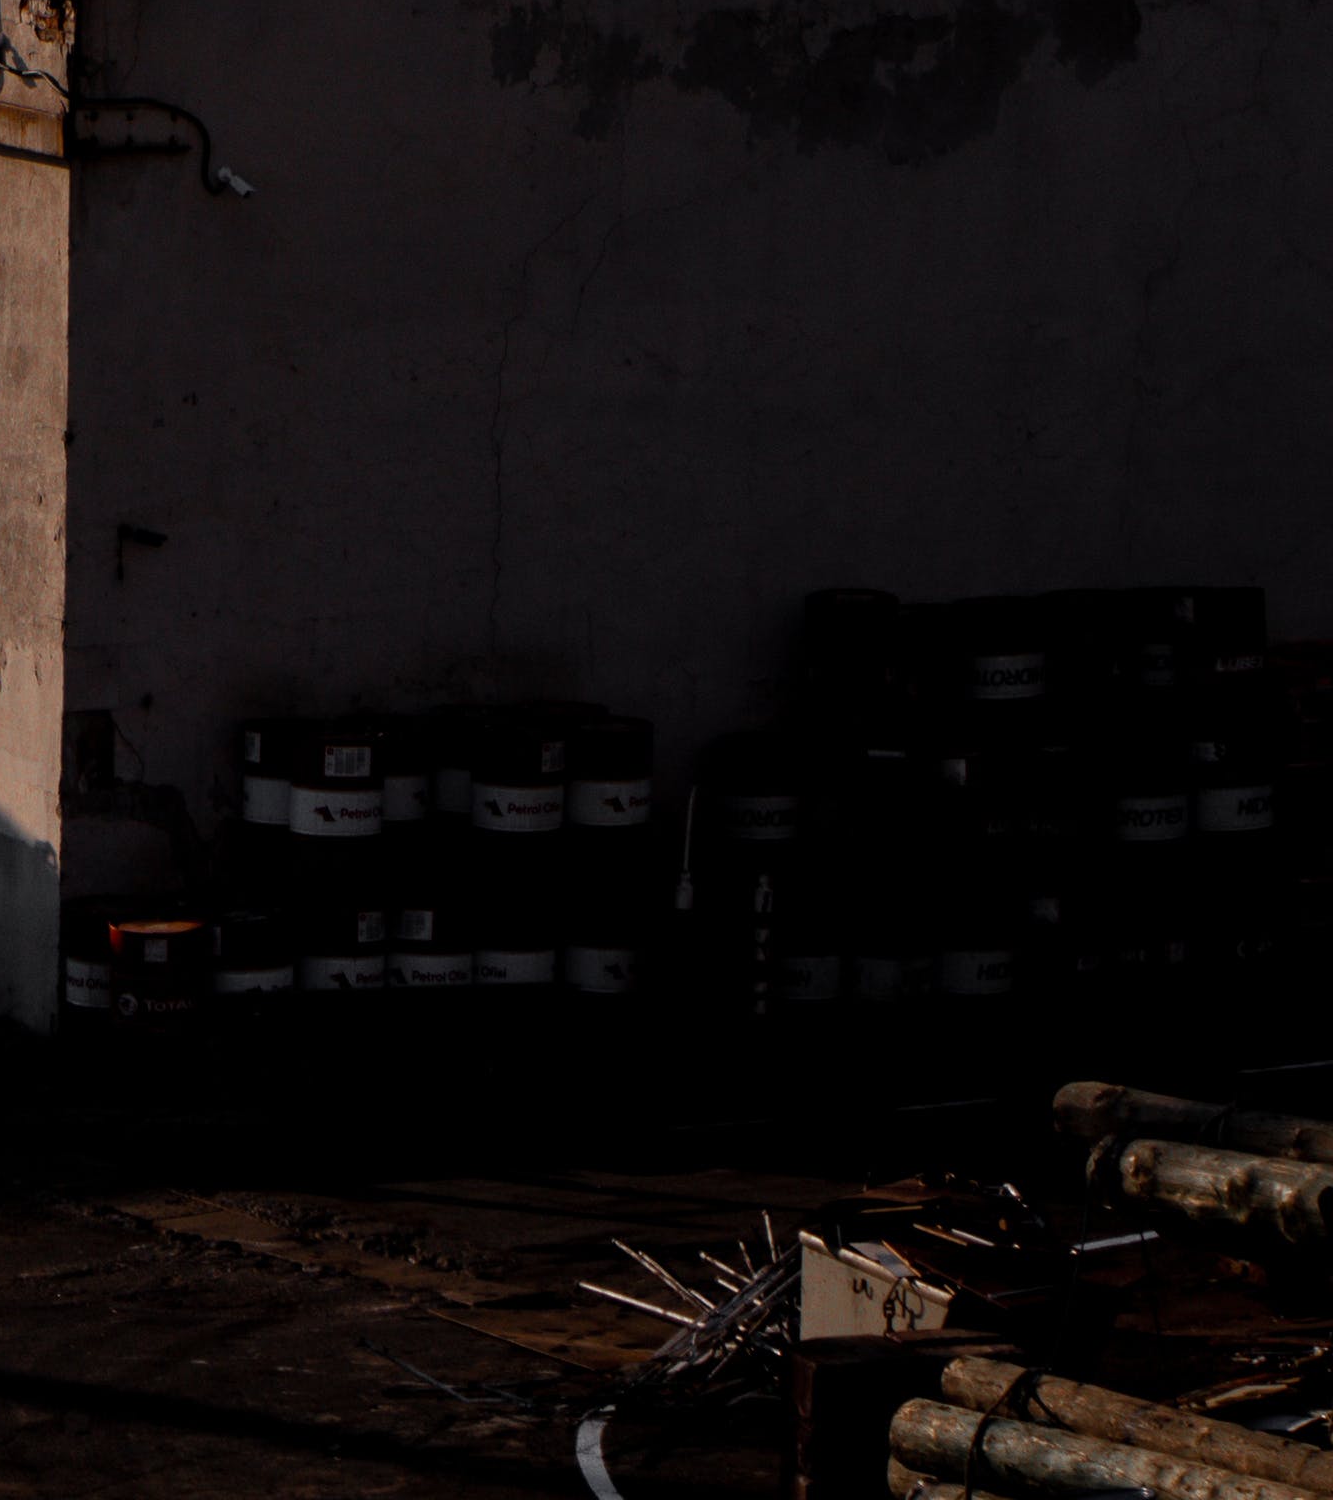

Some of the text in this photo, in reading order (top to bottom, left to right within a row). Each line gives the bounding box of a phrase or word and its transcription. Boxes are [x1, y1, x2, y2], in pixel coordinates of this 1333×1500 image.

[340, 807, 372, 819] Petrol
[507, 802, 541, 813] Petrol
[412, 970, 446, 983] Petrol
[141, 995, 197, 1012] TOTAL
